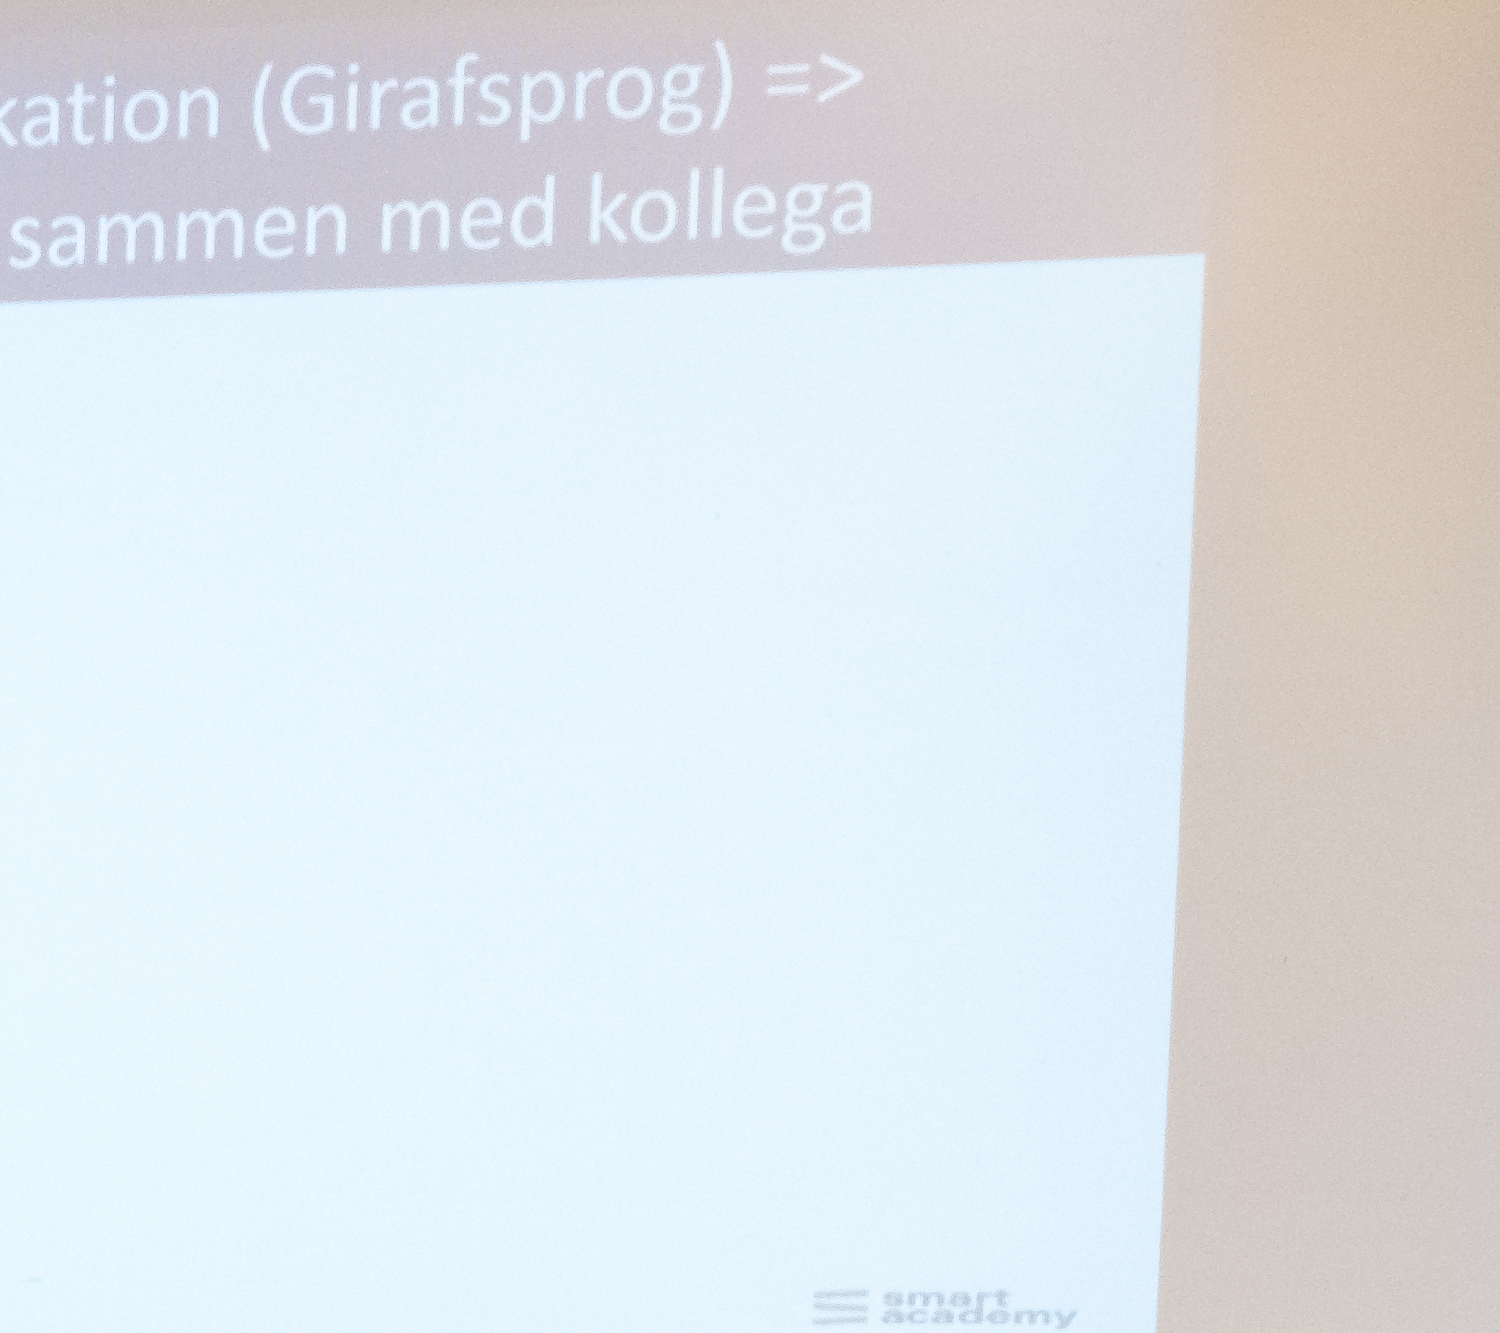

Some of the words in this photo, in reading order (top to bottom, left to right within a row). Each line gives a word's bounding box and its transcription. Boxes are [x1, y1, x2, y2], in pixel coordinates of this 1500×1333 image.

[252, 40, 733, 150] (Girafsprog)
[9, 200, 347, 269] sammen
[380, 175, 555, 252] med
[589, 167, 872, 254] kollega
[882, 1307, 1077, 1330] academy
[883, 1289, 1010, 1308] smart
